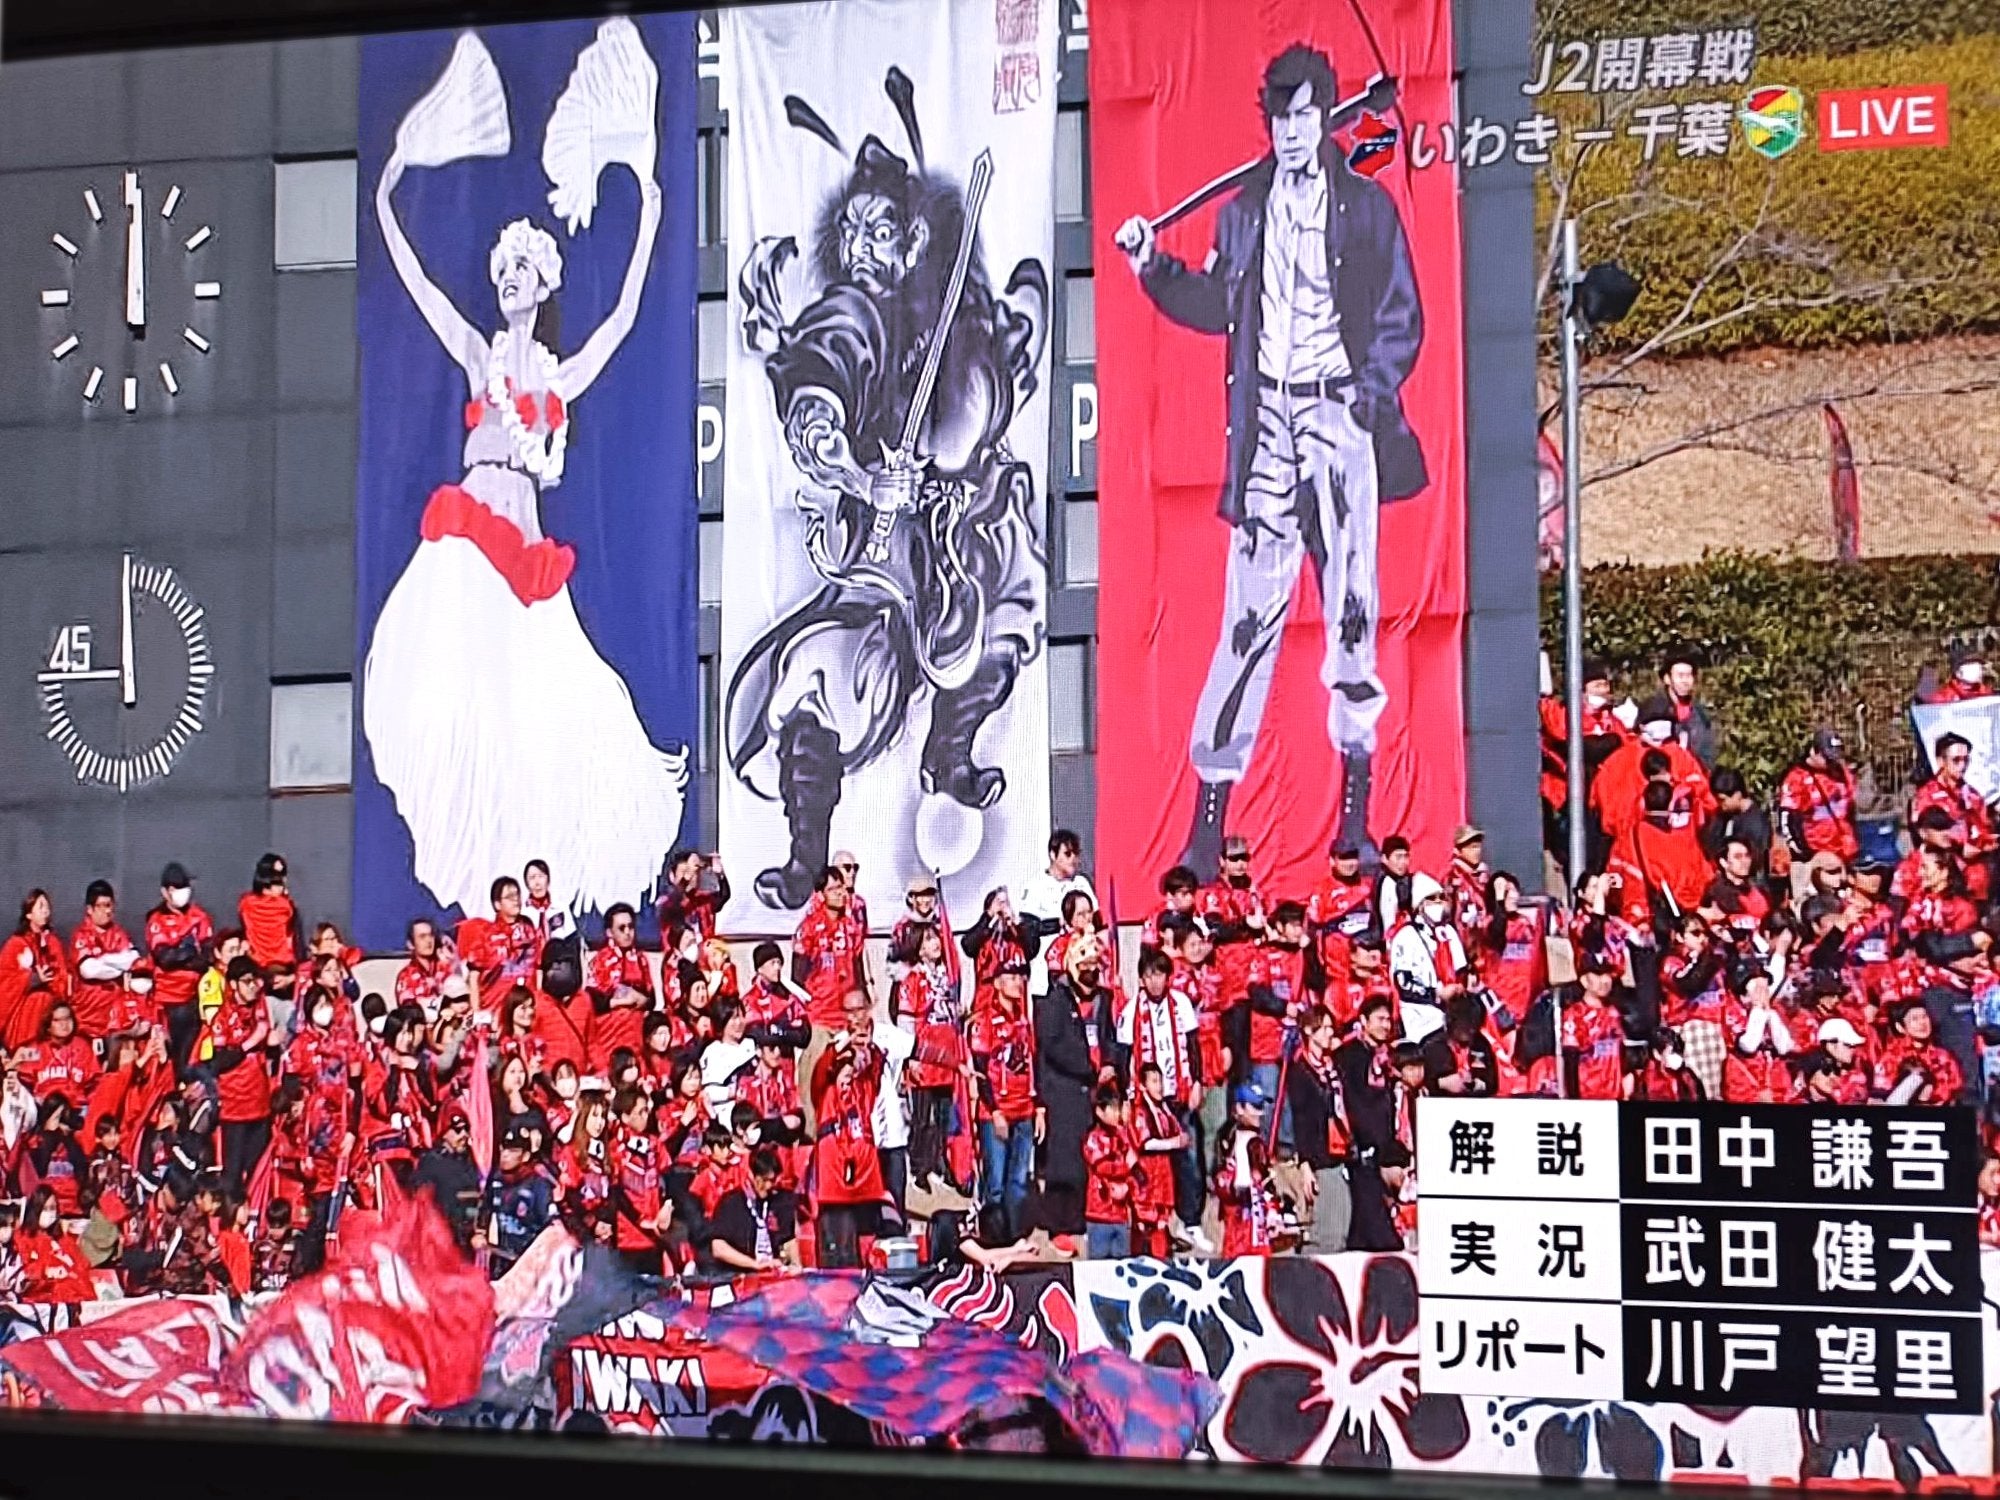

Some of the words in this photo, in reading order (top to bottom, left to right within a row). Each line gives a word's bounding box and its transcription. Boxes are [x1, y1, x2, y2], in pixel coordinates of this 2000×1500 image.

[1521, 30, 1755, 95] J2開幕戦
[1829, 95, 1935, 138] LIVE
[49, 625, 91, 672] 45
[1436, 1319, 1606, 1375] リポート
[571, 1349, 707, 1414] IWAKI
